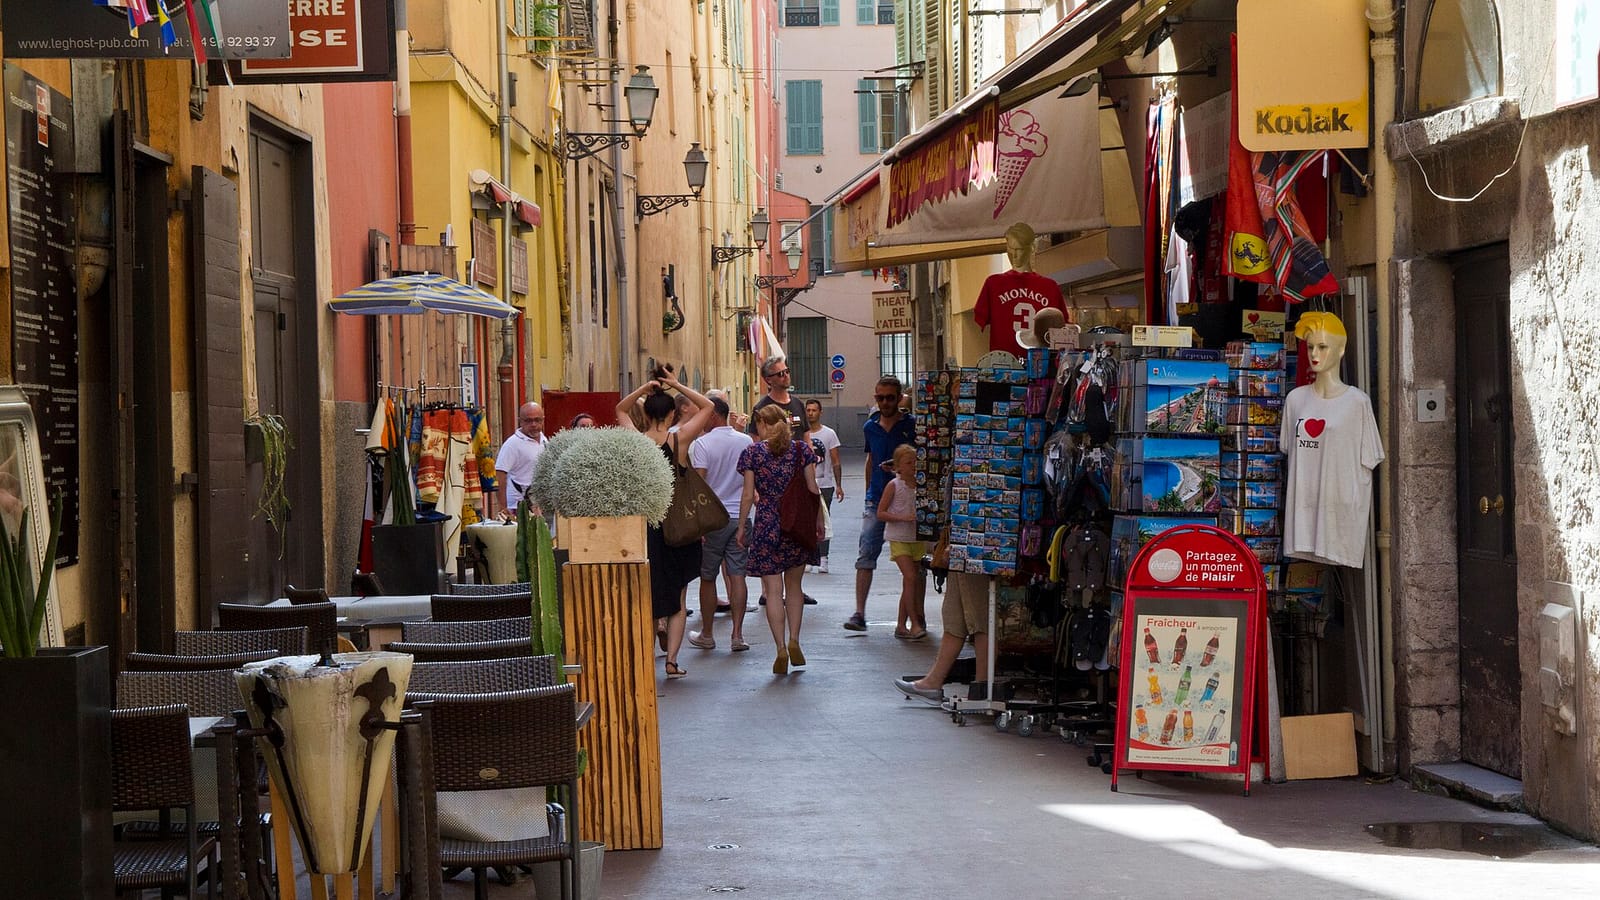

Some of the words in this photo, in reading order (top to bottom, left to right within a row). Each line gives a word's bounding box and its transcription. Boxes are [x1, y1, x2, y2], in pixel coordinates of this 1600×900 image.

[17, 37, 149, 50] www.leghost-pub.com
[227, 37, 242, 47] 92
[245, 37, 259, 47] 93
[263, 37, 276, 47] 37
[1256, 107, 1352, 135] Kodak
[998, 288, 1049, 307] MONACO
[892, 307, 905, 317] DE
[1013, 302, 1036, 332] 3
[876, 318, 912, 329] L'ATELI
[1296, 418, 1304, 437] I
[1299, 440, 1319, 448] NICE
[1186, 551, 1237, 562] Partagez
[1186, 563, 1198, 572] un
[1201, 562, 1243, 572] moment
[1185, 572, 1198, 581] de
[1202, 572, 1235, 581] Plaisir
[1200, 747, 1222, 755] Coca-Cola
